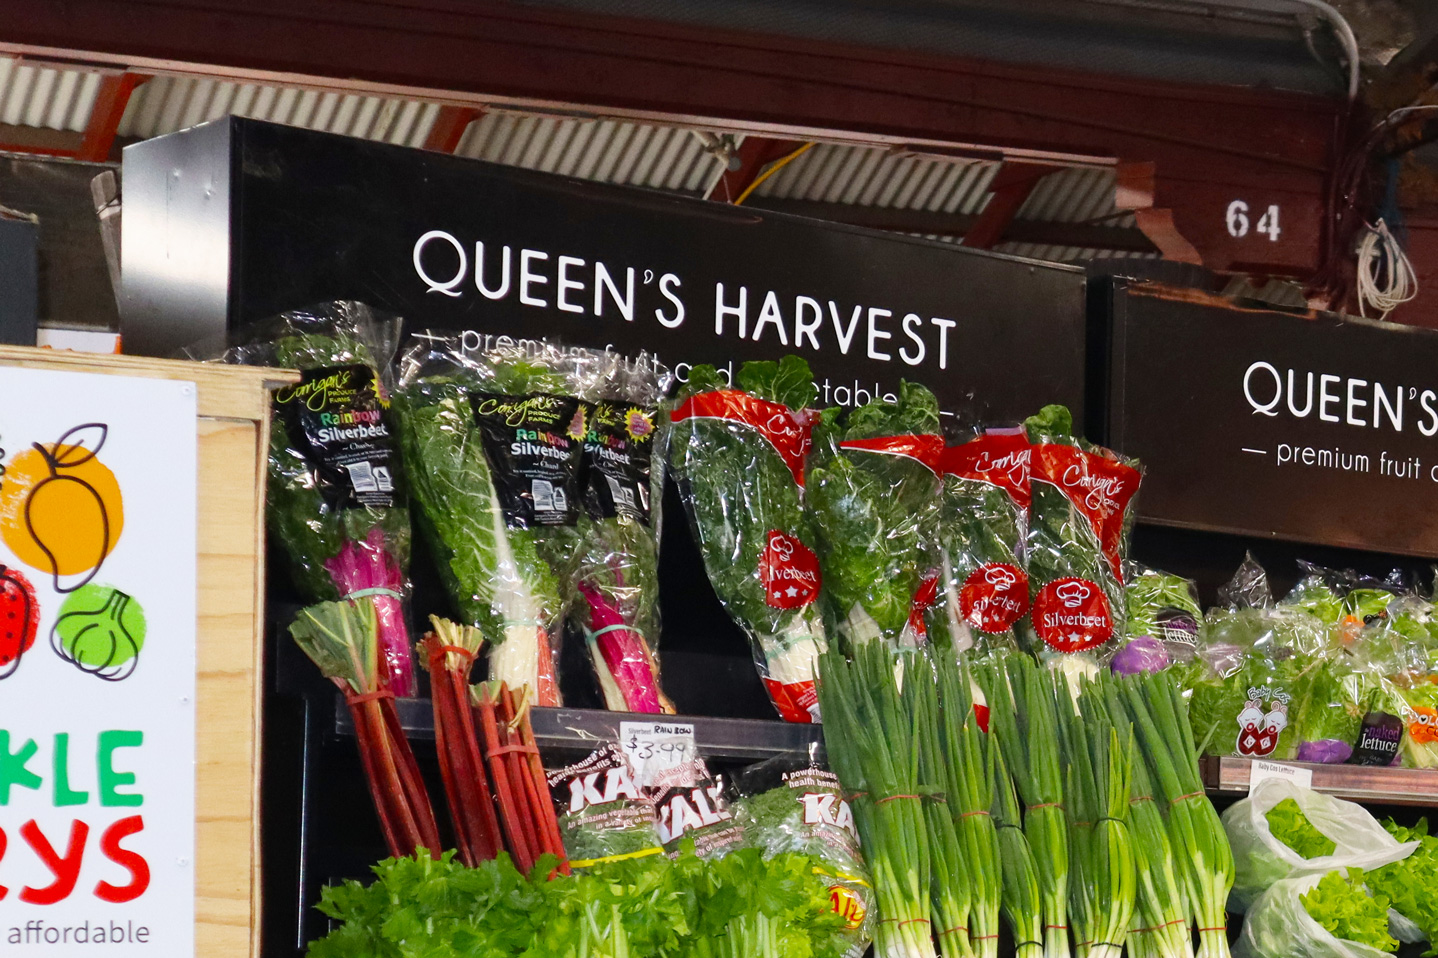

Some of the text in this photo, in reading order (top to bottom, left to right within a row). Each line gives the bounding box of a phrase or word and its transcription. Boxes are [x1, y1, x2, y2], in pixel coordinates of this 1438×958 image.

[1226, 200, 1281, 241] 64
[412, 229, 956, 369] QUEEN'S HARVEST
[1243, 361, 1438, 437] QUEEN'S
[320, 408, 382, 427] Rainbow
[317, 422, 390, 444] Silverbeet
[1277, 442, 1369, 472] premium
[1379, 452, 1421, 479] fruit
[1043, 613, 1106, 629] Silverbeet
[1361, 733, 1398, 752] lettuce
[781, 767, 838, 781] A powerhouse
[788, 776, 816, 789] health
[7, 920, 150, 943] affordable
